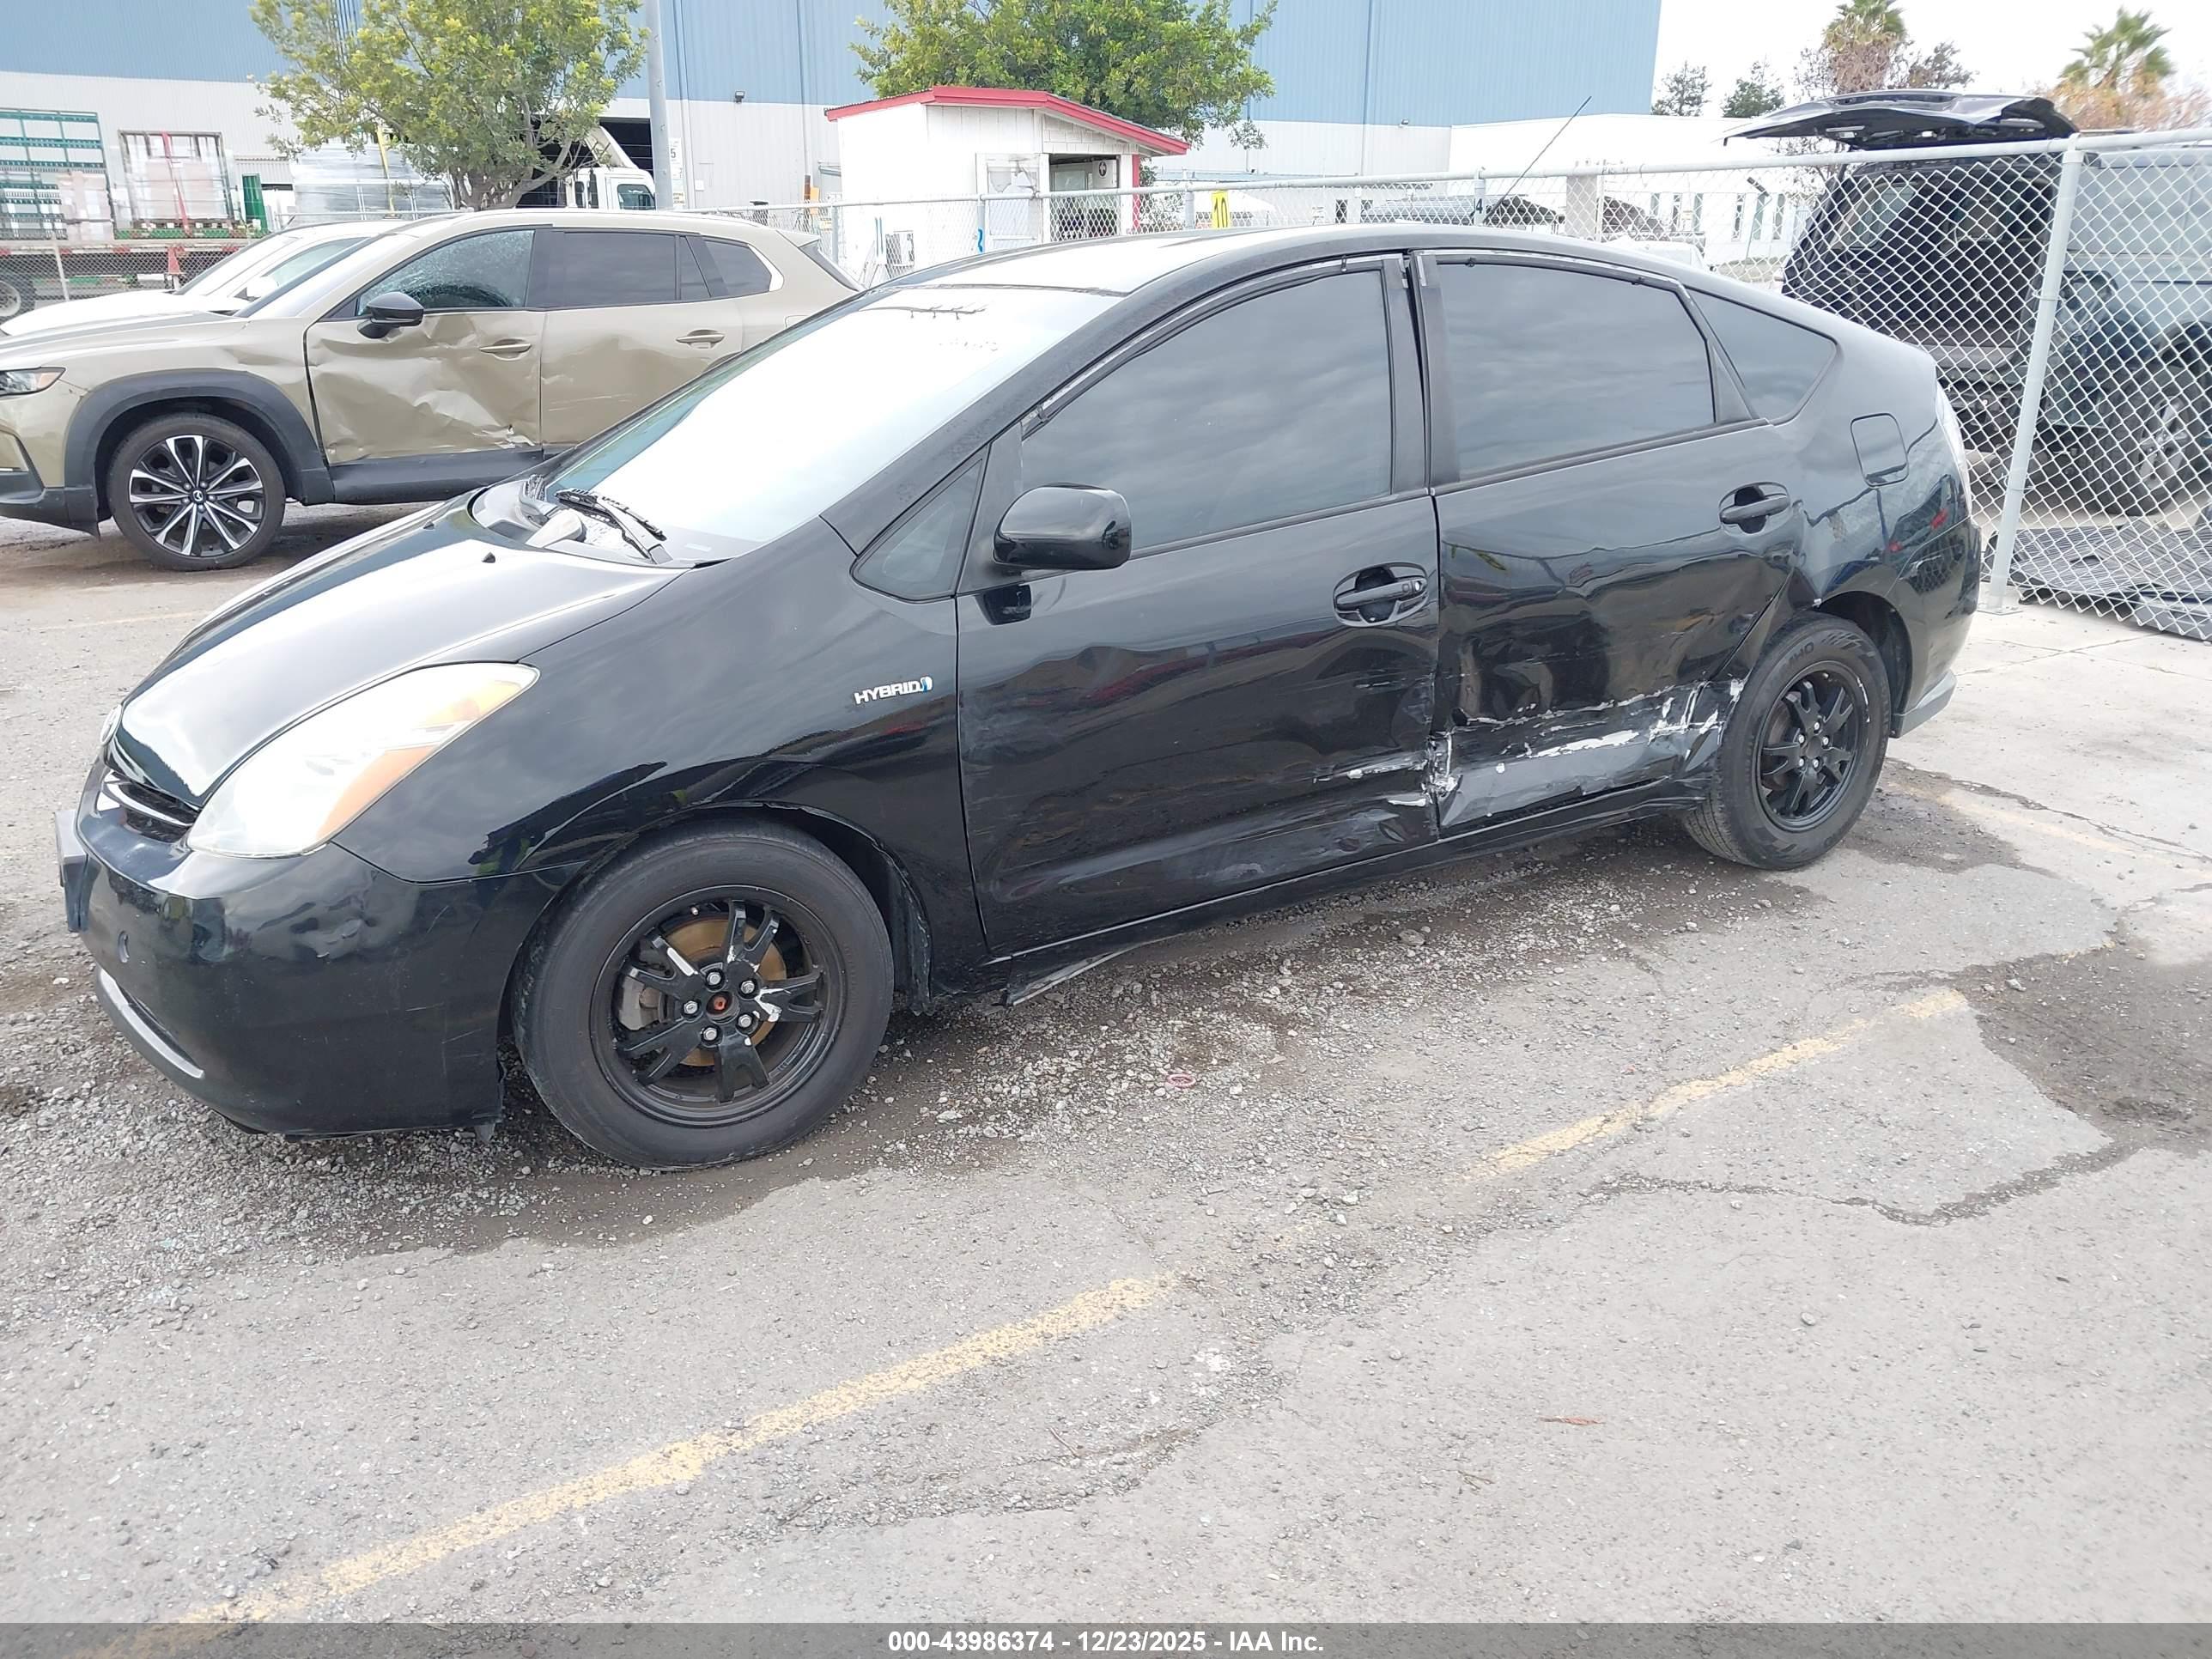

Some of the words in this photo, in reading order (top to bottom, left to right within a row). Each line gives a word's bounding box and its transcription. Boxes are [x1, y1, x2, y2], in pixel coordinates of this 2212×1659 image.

[1213, 197, 1228, 228] 10
[1476, 198, 1483, 214] 4
[854, 679, 922, 705] HYBRID
